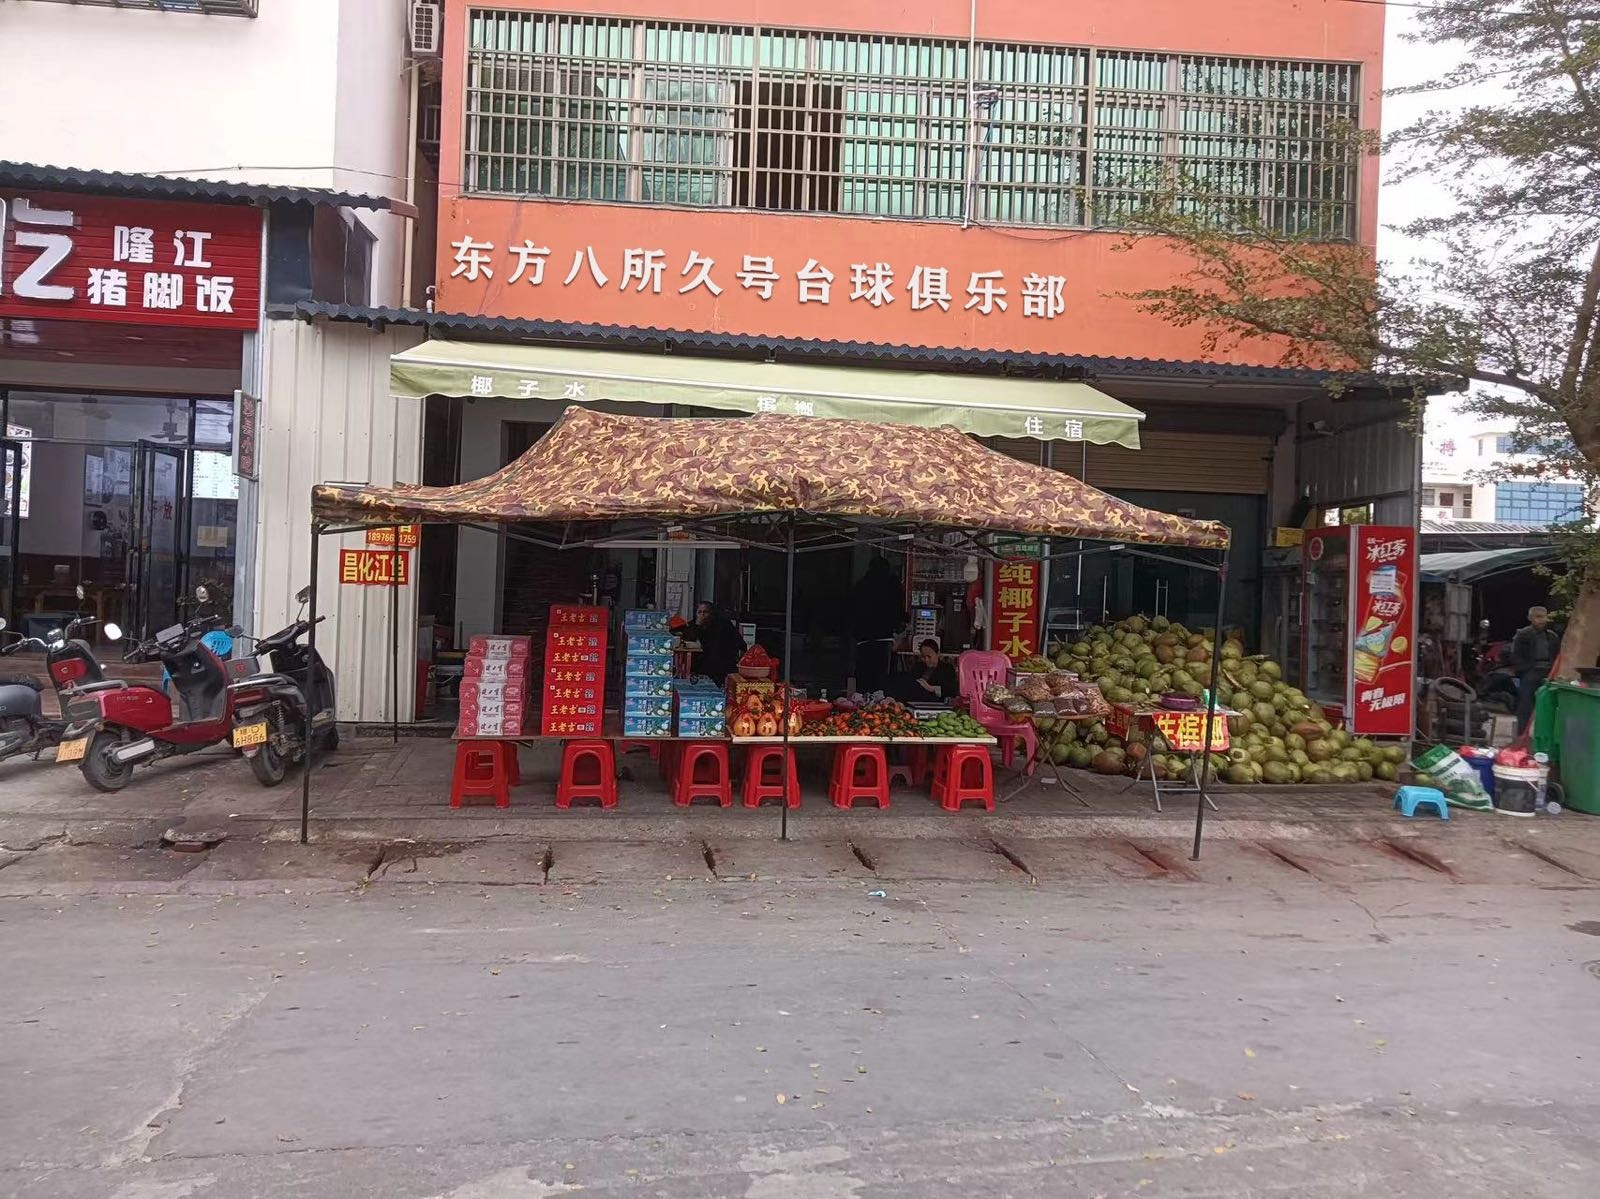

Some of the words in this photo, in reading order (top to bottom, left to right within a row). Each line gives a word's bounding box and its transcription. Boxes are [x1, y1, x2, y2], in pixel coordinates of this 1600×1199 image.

[113, 225, 213, 269] 隆江
[87, 268, 235, 314] 猪脚饭
[450, 235, 1068, 320] 东方八所久号台球俱乐部
[471, 376, 586, 399] 椰子水
[1024, 416, 1084, 439] 住宿
[997, 563, 1034, 657] 纯椰子水
